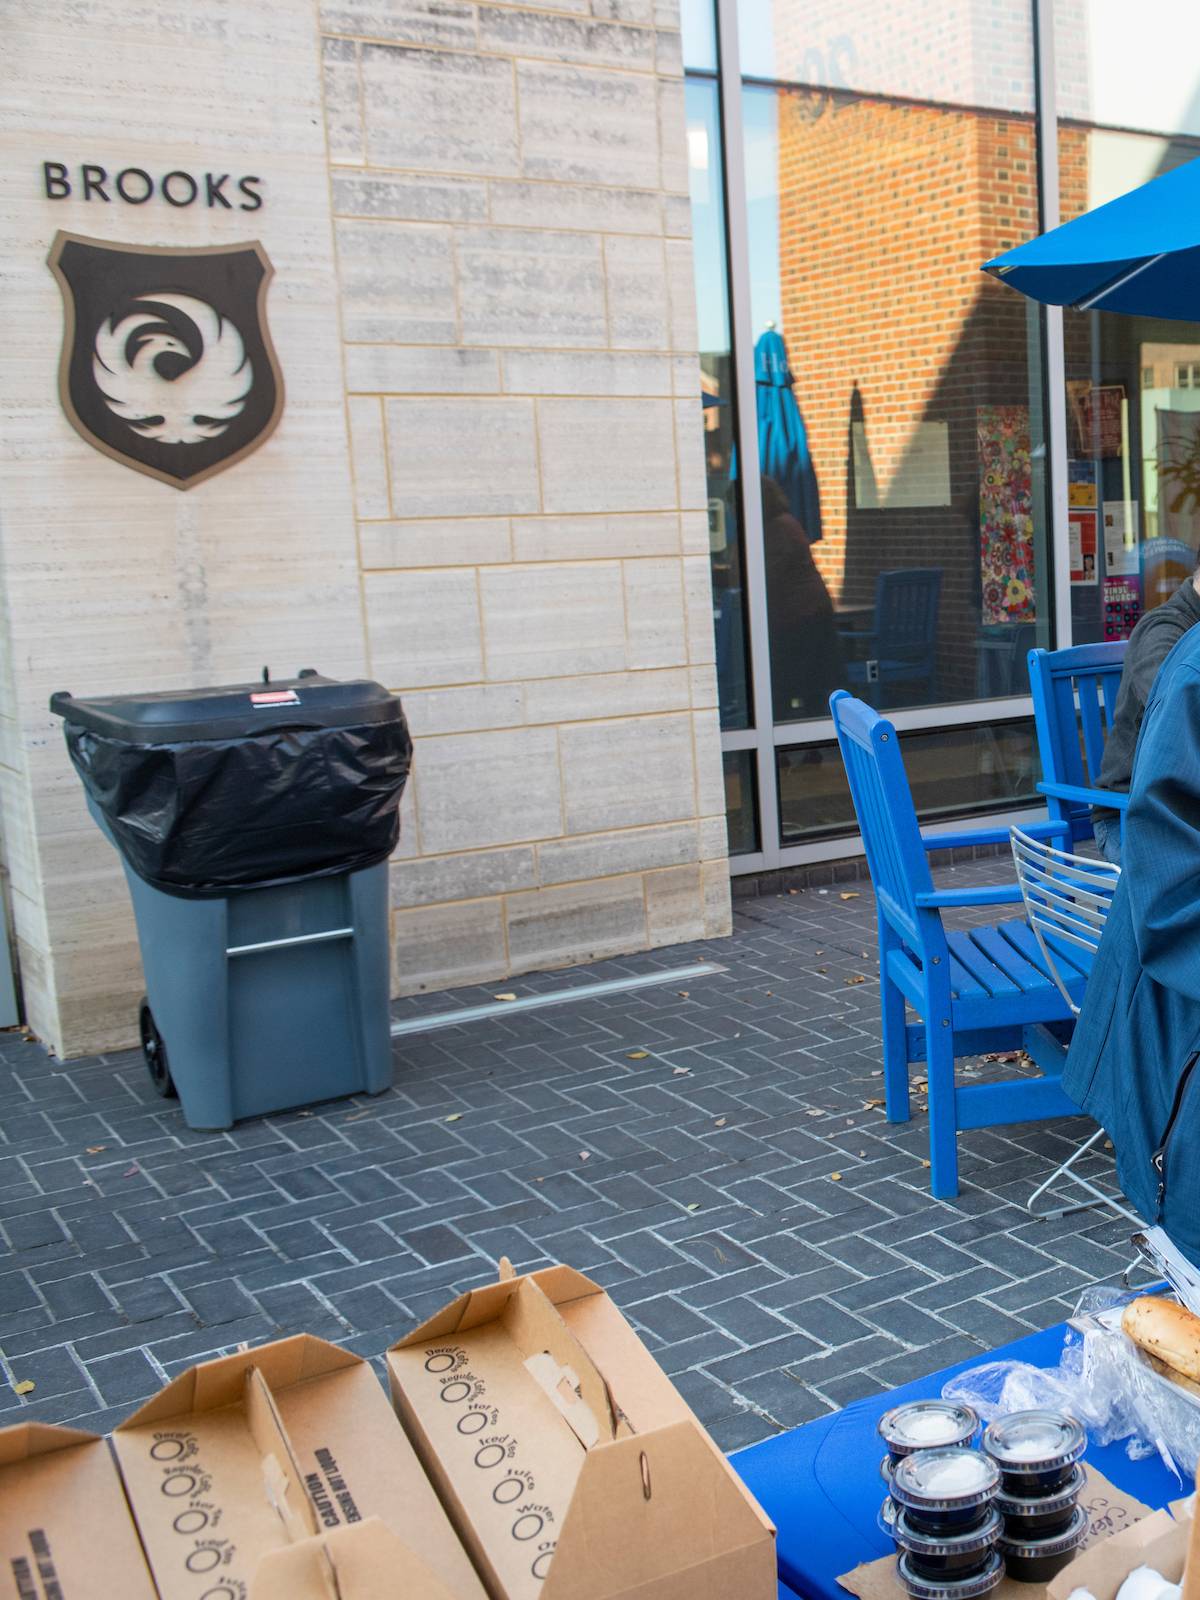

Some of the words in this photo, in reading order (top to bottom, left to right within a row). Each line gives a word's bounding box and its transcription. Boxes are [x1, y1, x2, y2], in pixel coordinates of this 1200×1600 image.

[43, 161, 263, 212] BROOKS
[479, 1434, 509, 1446] Iced
[507, 1439, 518, 1458] Tea
[504, 1468, 535, 1491] Juice
[304, 1472, 340, 1528] CAUTION
[515, 1503, 554, 1523] Water
